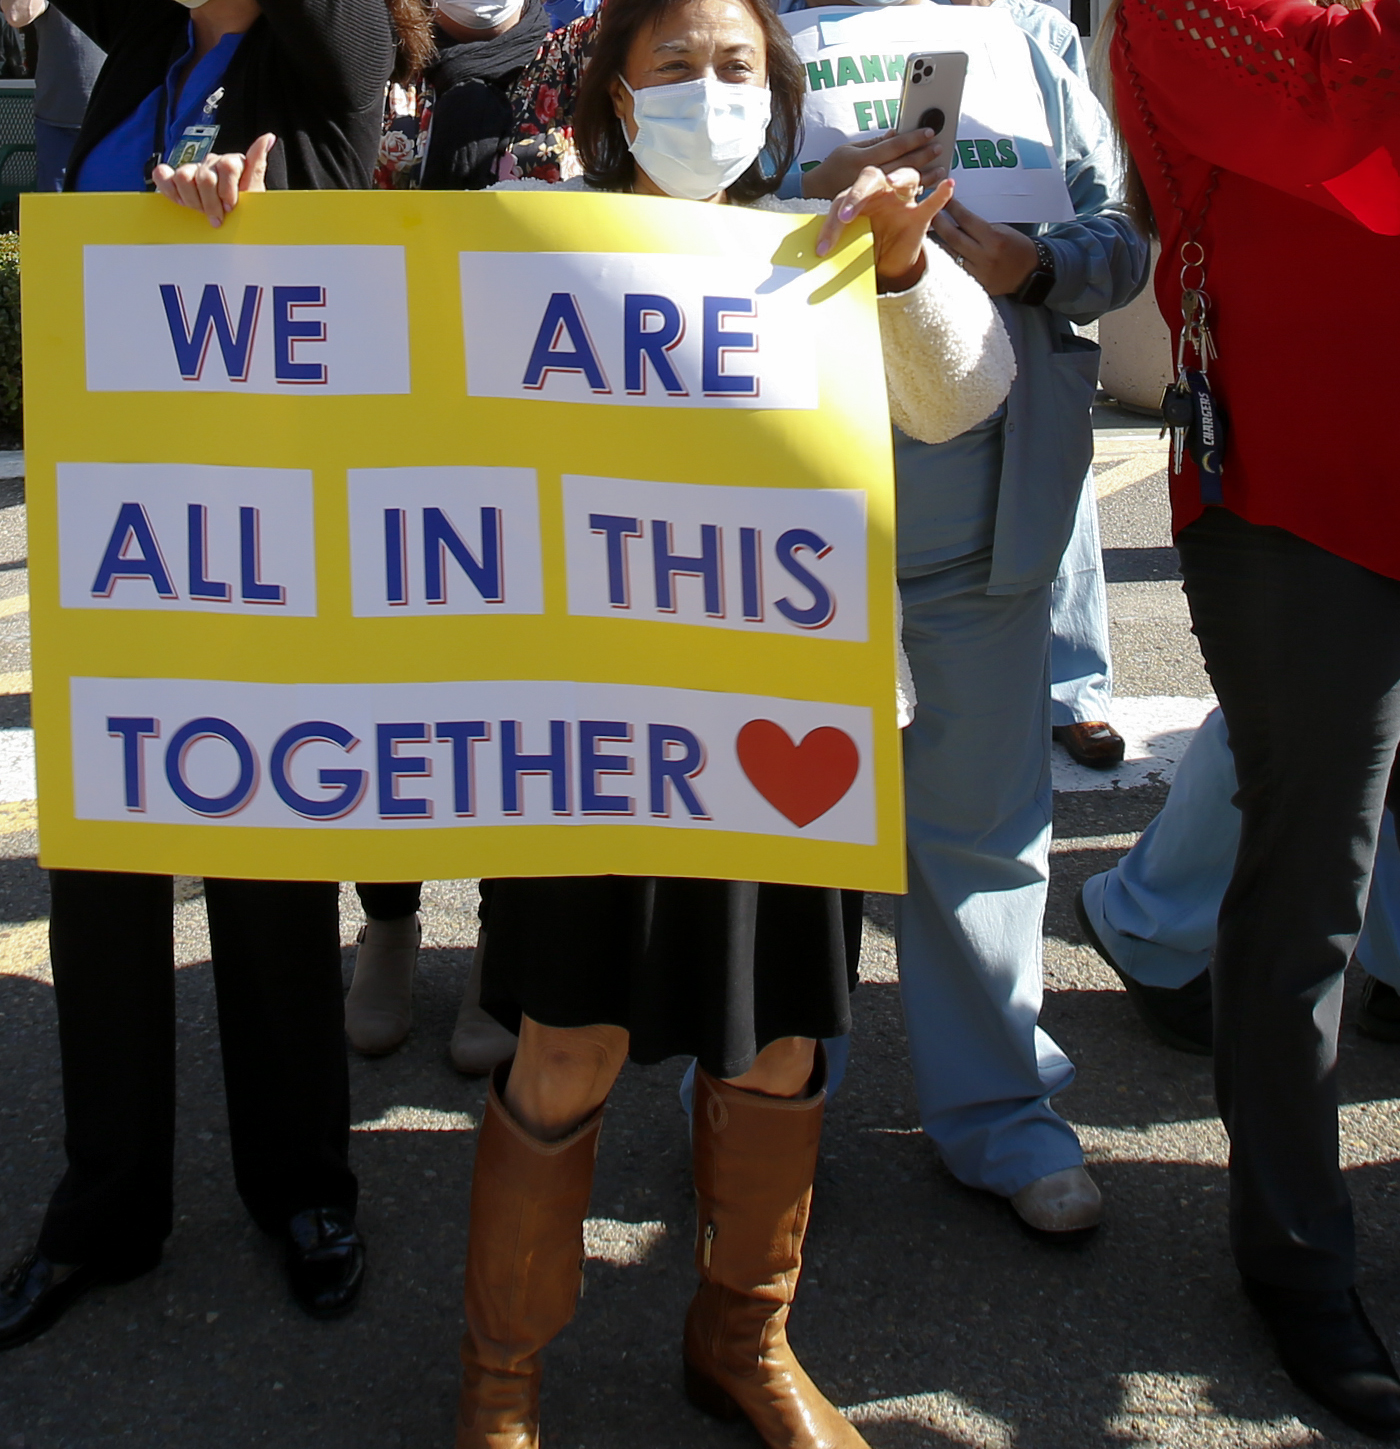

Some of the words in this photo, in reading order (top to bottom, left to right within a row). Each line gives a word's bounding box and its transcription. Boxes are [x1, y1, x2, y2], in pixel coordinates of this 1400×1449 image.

[158, 283, 327, 384] WE
[522, 291, 760, 397] ARE
[1198, 391, 1215, 446] CHARGERS
[91, 502, 286, 606] ALL
[384, 506, 504, 606] IN
[588, 513, 837, 630] THIS
[106, 715, 714, 821] TOGETHER
